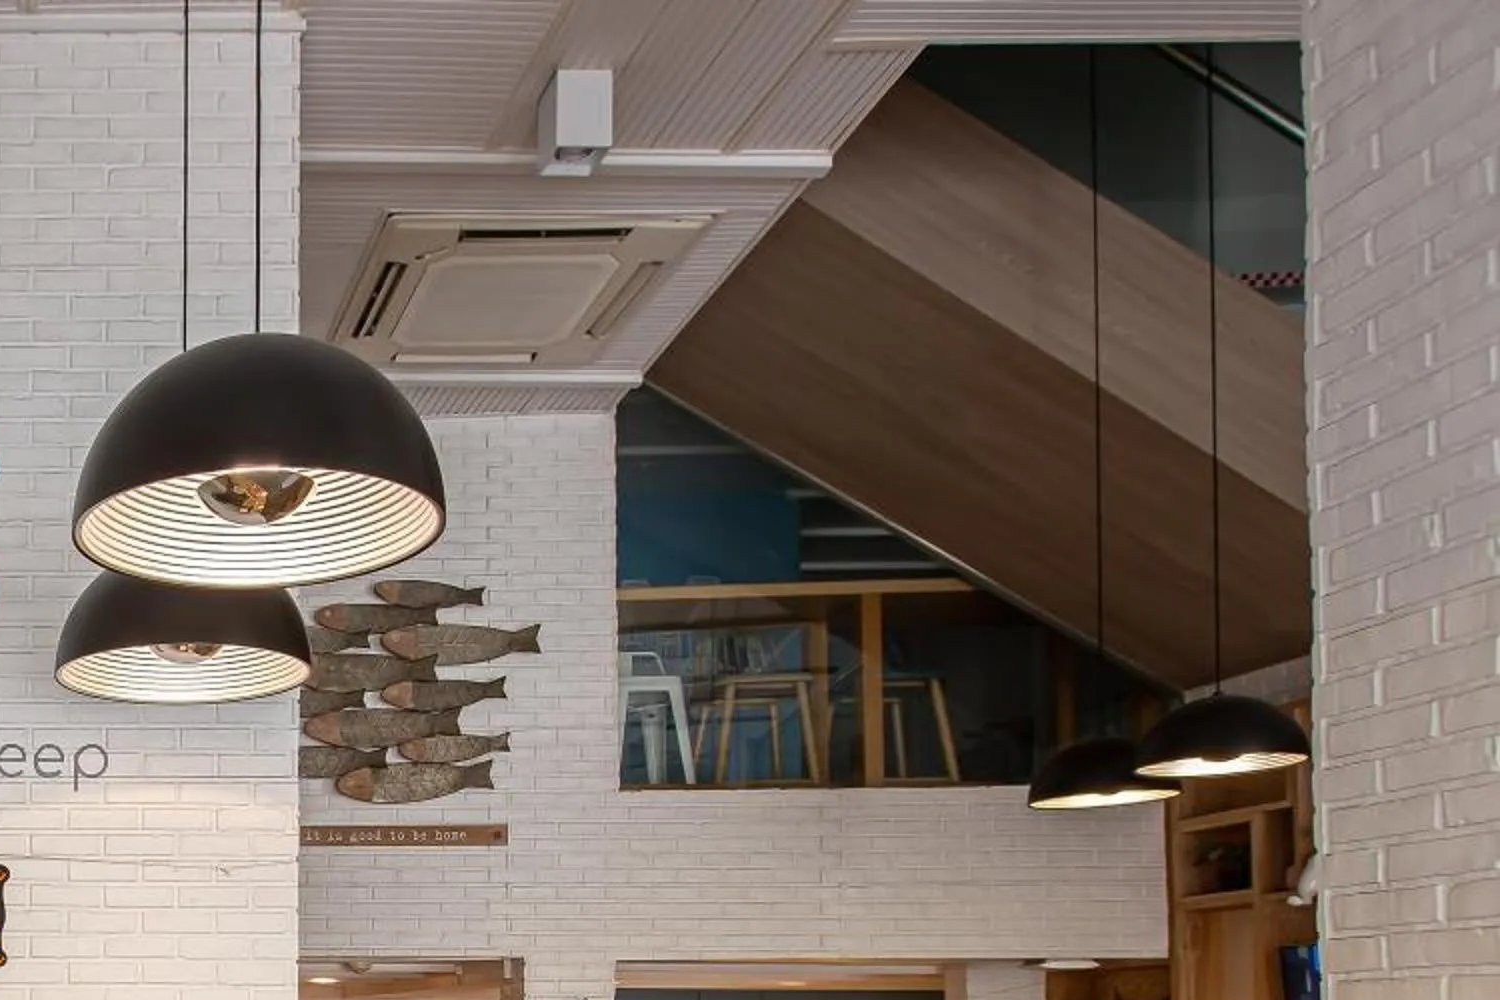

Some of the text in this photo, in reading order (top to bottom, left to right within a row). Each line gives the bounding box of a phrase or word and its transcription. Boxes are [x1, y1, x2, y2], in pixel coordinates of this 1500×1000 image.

[350, 830, 382, 842] good
[389, 830, 405, 841] to
[412, 830, 427, 841] be
[435, 830, 467, 841] home
